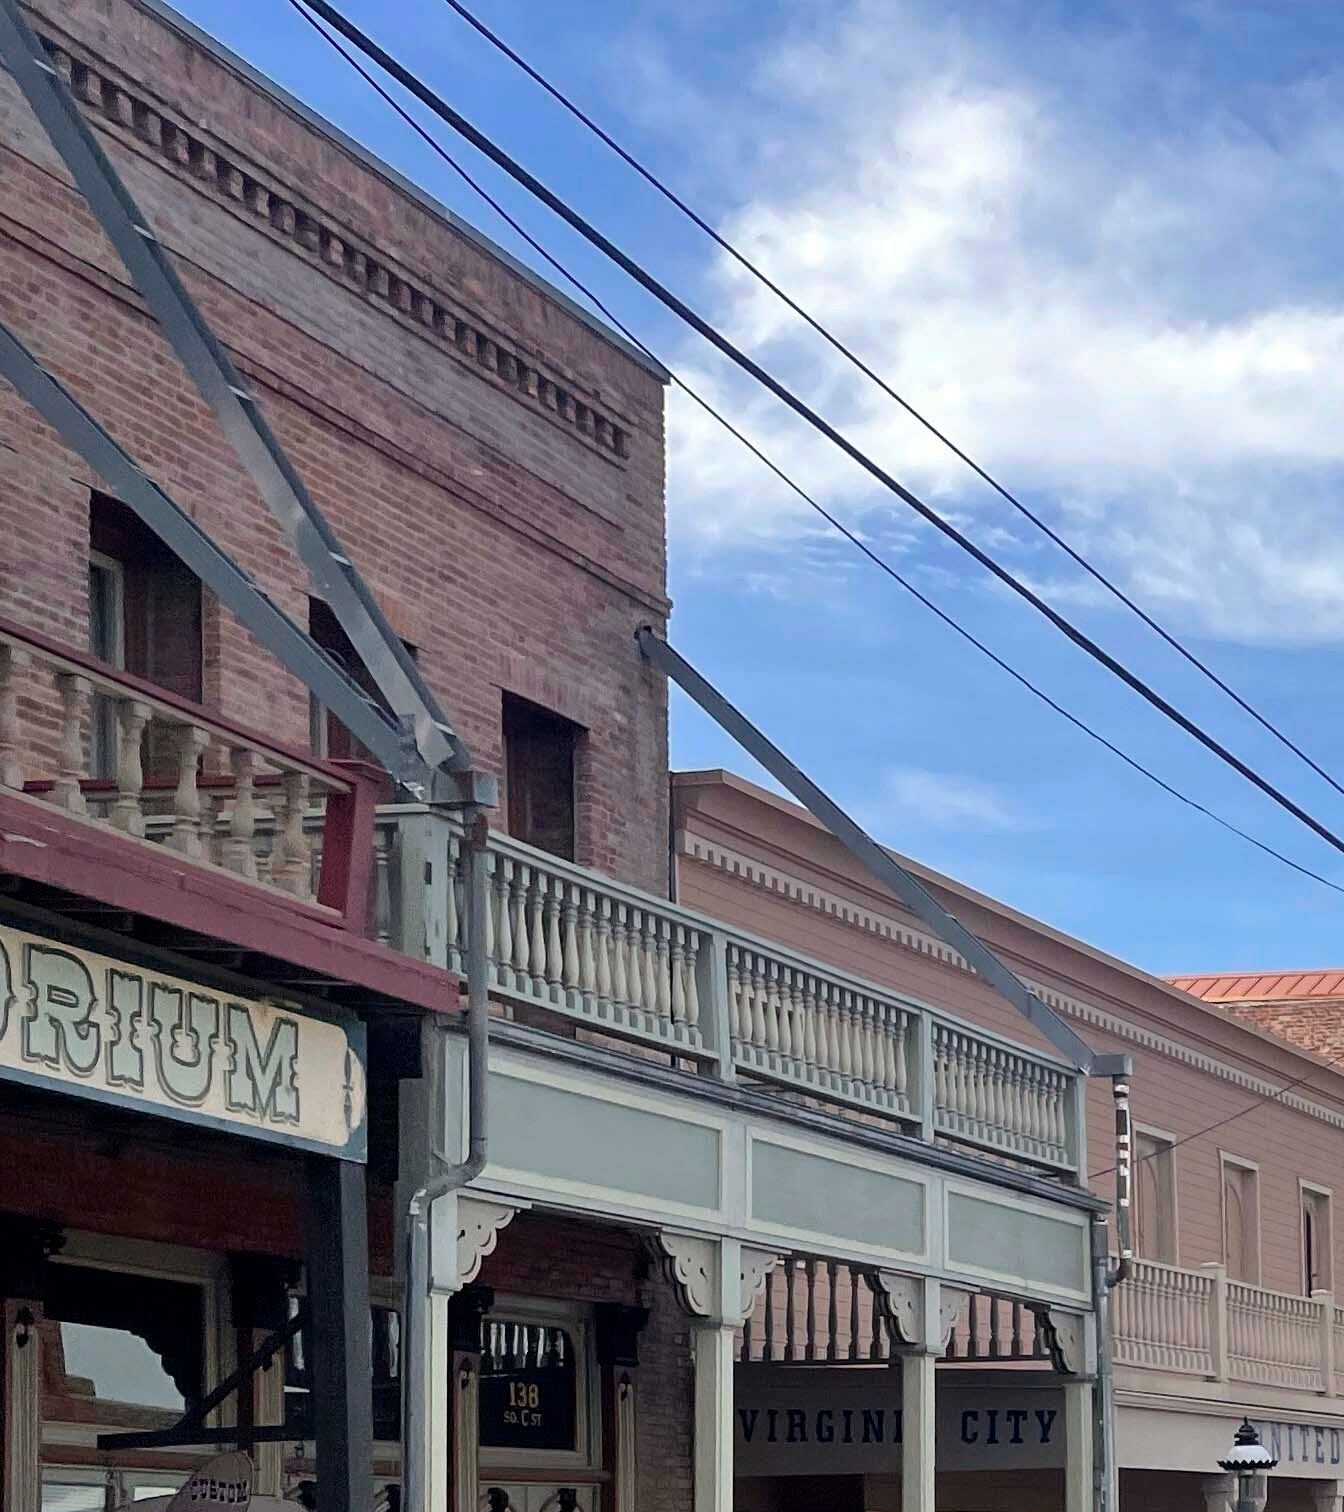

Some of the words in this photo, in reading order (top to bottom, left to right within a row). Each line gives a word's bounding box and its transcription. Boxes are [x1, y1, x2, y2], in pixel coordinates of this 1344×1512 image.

[0, 938, 300, 1130] RIUM
[508, 1381, 540, 1409] 138
[520, 1409, 530, 1427] C
[737, 1408, 904, 1444] VIRGINI
[960, 1408, 1057, 1445] CITY
[1256, 1421, 1341, 1465] NITED
